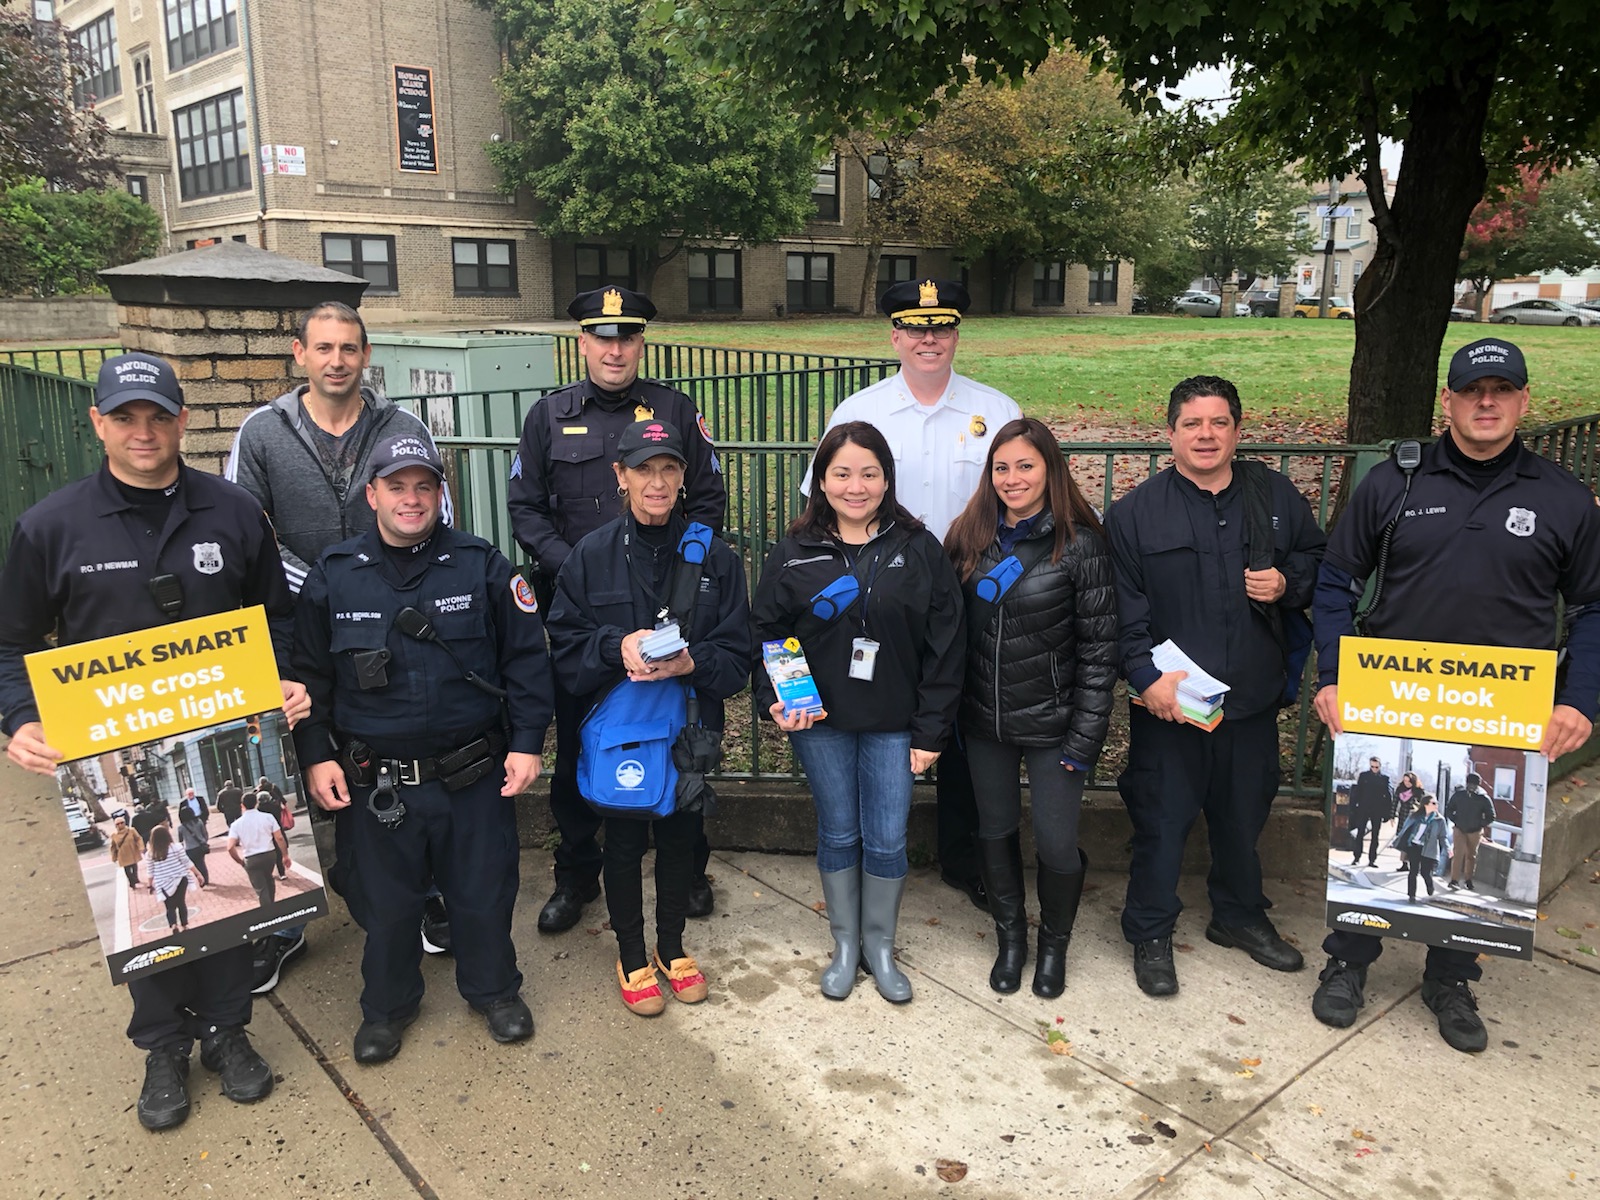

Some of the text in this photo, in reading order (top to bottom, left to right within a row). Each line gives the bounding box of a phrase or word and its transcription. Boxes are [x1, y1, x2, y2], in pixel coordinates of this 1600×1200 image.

[399, 87, 428, 97] SCHOOL
[284, 147, 297, 156] NO
[279, 164, 288, 173] NO
[417, 160, 435, 168] Winner
[1468, 345, 1509, 358] BAYONNE
[1471, 355, 1505, 365] POLICE
[114, 361, 160, 376] BAYONNE
[119, 373, 157, 384] POLICE
[1426, 506, 1446, 515] LEWIS
[104, 560, 139, 571] NEWMAN
[434, 594, 473, 607] BAYONNE
[440, 602, 471, 613] POLICE
[52, 625, 249, 684] WALK SMART
[1357, 652, 1536, 682] WALK SMART
[95, 664, 225, 708] We cross
[1390, 680, 1495, 708] We look
[88, 686, 246, 742] at the light
[1343, 702, 1543, 744] before crossing
